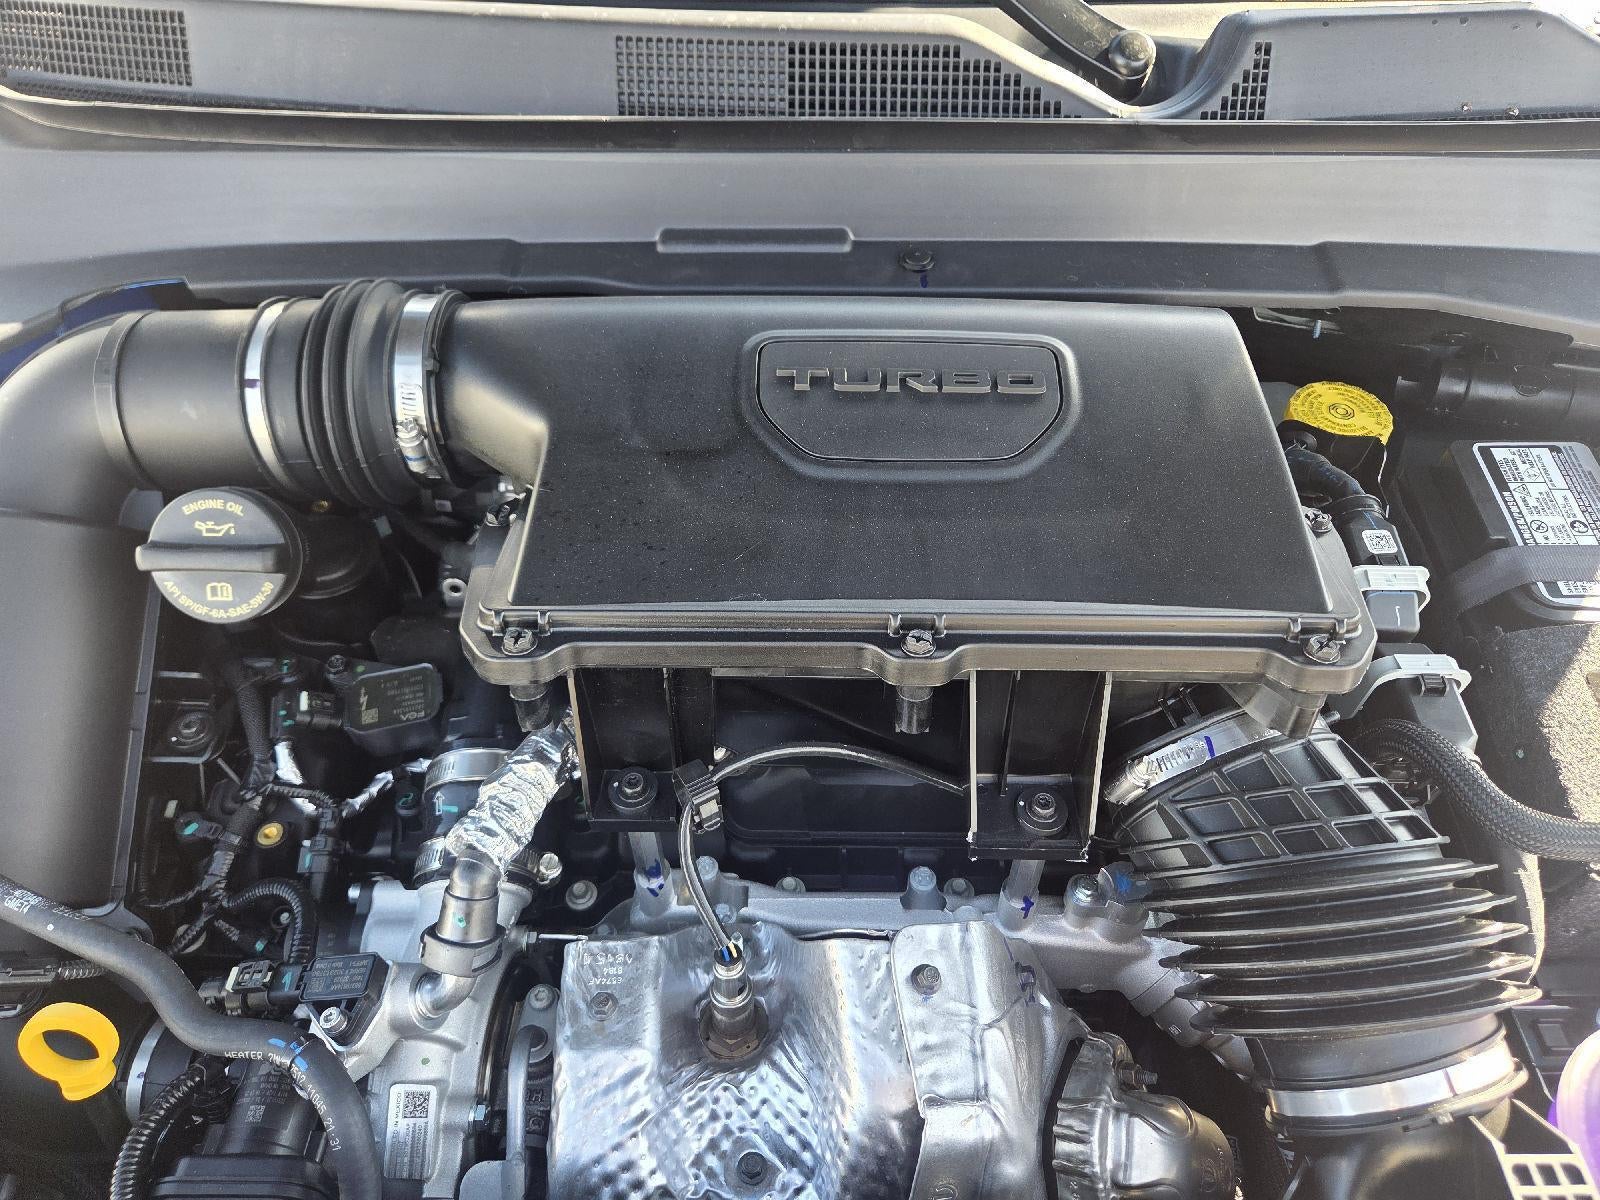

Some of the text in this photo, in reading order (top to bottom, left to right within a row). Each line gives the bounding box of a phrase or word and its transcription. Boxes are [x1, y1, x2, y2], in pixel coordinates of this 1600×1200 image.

[776, 367, 1047, 394] TURBO
[182, 499, 244, 516] ENGINE OIL
[164, 581, 181, 598] API
[224, 1051, 263, 1061] HEATER
